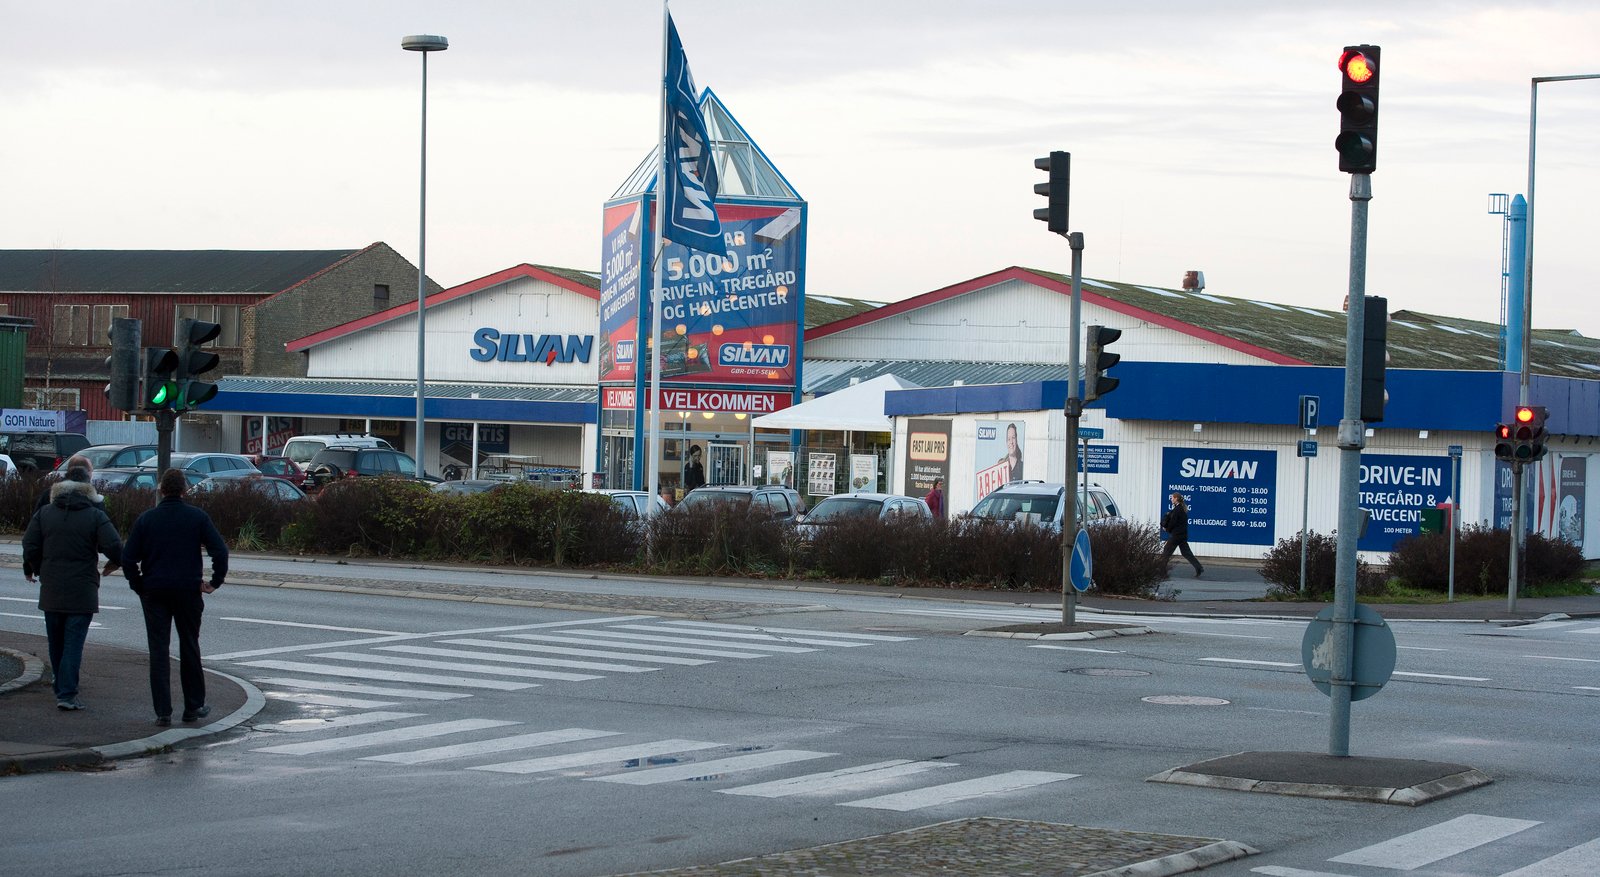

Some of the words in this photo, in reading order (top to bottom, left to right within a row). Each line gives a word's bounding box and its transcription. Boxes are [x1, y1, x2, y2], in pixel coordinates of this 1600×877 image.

[606, 250, 625, 284] 5.000
[667, 250, 739, 281] 5.000
[746, 248, 774, 271] m²
[721, 270, 796, 293] TRÆGÅRD
[664, 305, 685, 320] OG
[690, 292, 788, 316] HAVECENTER
[470, 327, 594, 365] SILVAN
[616, 344, 634, 359] SILVAN
[722, 346, 786, 364] SILVAN
[607, 390, 635, 407] VELKOMMEN
[663, 391, 775, 411] VELKOMMEN
[4, 415, 27, 427] GORI
[29, 416, 55, 427] Nature
[1307, 400, 1317, 426] P
[979, 428, 996, 438] SILVAN
[912, 440, 924, 453] FAST
[924, 440, 933, 453] LAV
[934, 441, 945, 454] PRIS
[1180, 458, 1258, 480] SILVAN
[1359, 465, 1441, 486] DRIVE-IN
[1168, 484, 1195, 492] MANDAG
[1199, 485, 1227, 493] TORSDAG
[1251, 487, 1268, 495] 18.00
[1359, 489, 1423, 506] TRÆGÅRD
[1427, 494, 1437, 507] &
[1250, 497, 1268, 505] 19.00
[1193, 518, 1227, 527] HELLIGDAGE
[1249, 520, 1267, 528] 16.00
